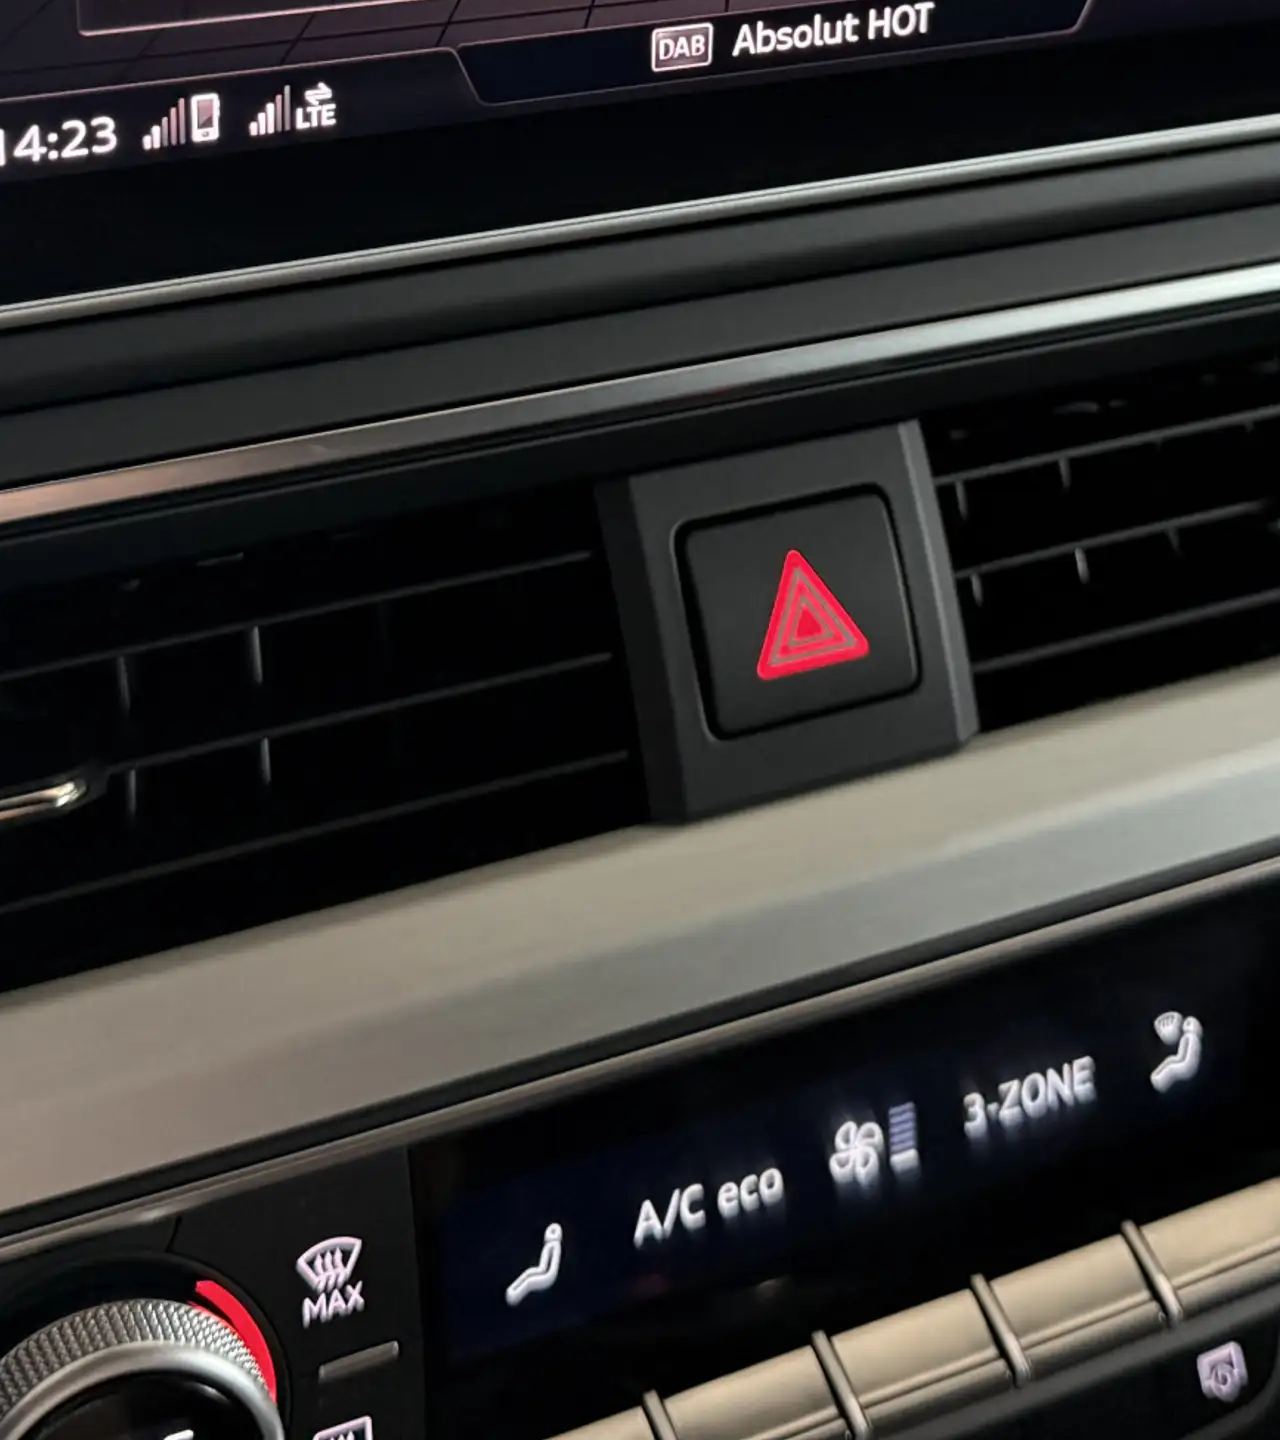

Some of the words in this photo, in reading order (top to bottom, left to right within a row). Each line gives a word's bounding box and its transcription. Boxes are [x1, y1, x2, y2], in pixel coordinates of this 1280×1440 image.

[658, 33, 706, 61] DAB
[732, 13, 859, 57] Absolut
[868, 2, 935, 40] HOT
[295, 103, 337, 130] LTE
[964, 1056, 1093, 1137] 3-ZONE
[634, 1184, 705, 1245] A/C
[718, 1168, 783, 1217] eco
[301, 1279, 366, 1328] MAX
